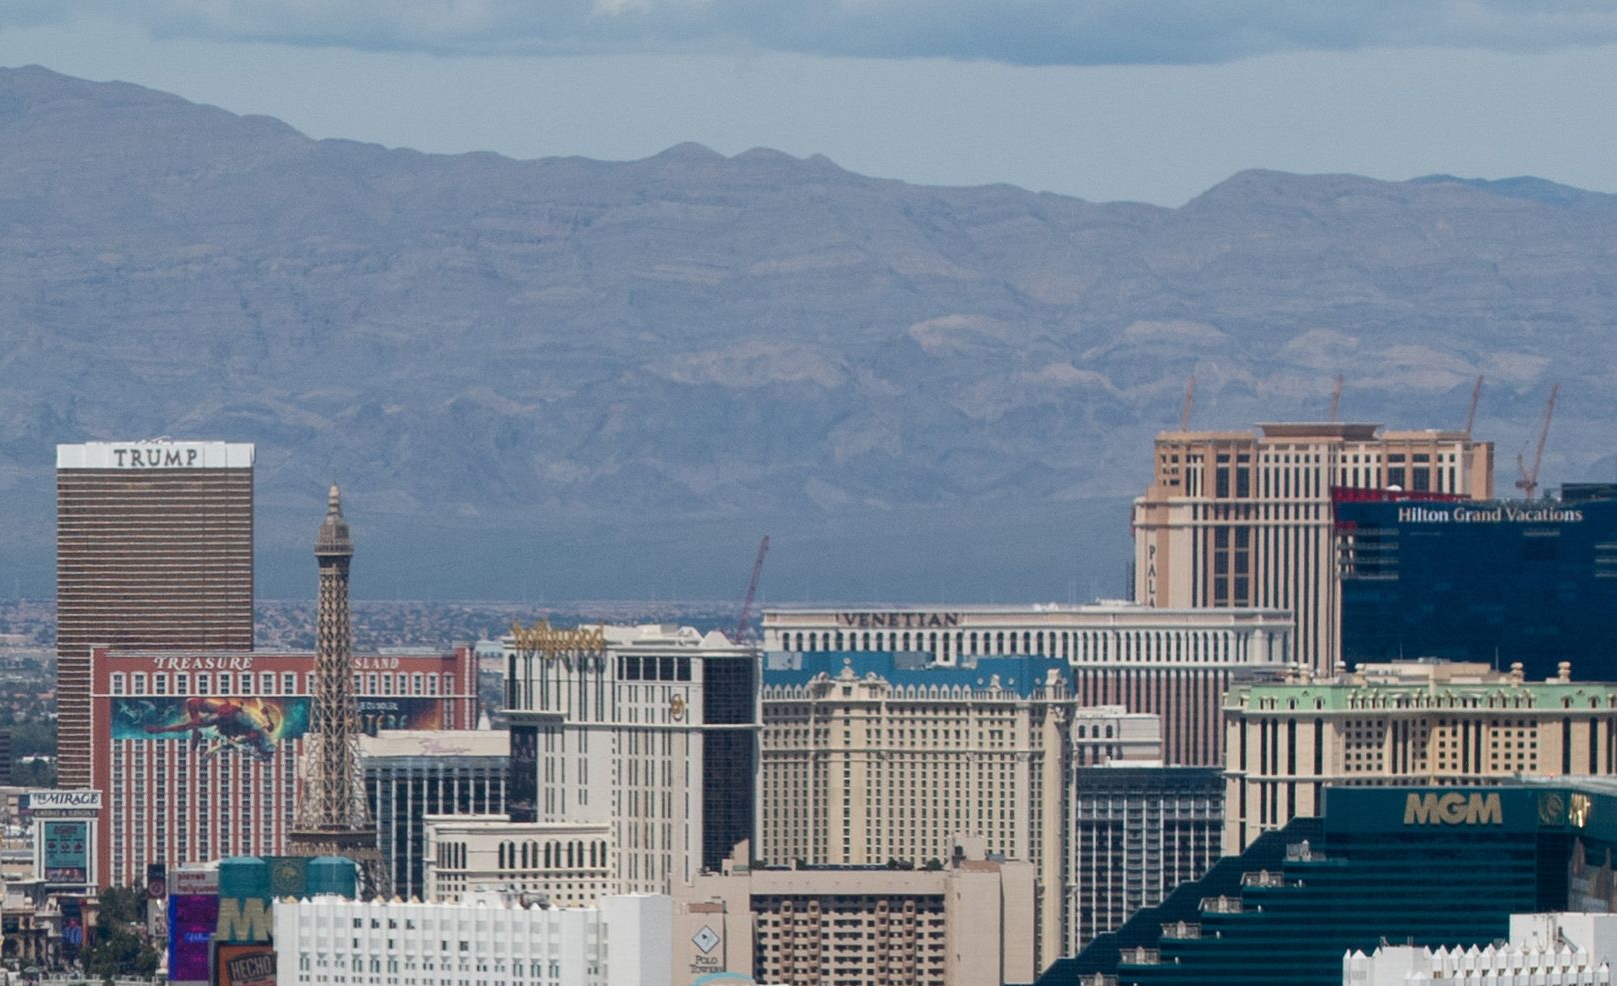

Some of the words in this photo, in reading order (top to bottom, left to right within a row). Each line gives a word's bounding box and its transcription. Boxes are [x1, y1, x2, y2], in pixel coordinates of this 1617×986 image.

[113, 448, 198, 467] TRUMP
[1398, 507, 1449, 523] Hilton
[1453, 507, 1502, 523] Grand
[1505, 507, 1583, 523] Vacations
[842, 612, 959, 627] VENETIAN
[153, 657, 253, 670] TREASURE
[354, 657, 400, 670] SLAND
[39, 791, 99, 805] MIRAGE
[1403, 792, 1504, 825] MGM
[695, 954, 718, 965] POLO
[230, 955, 272, 982] HECHO
